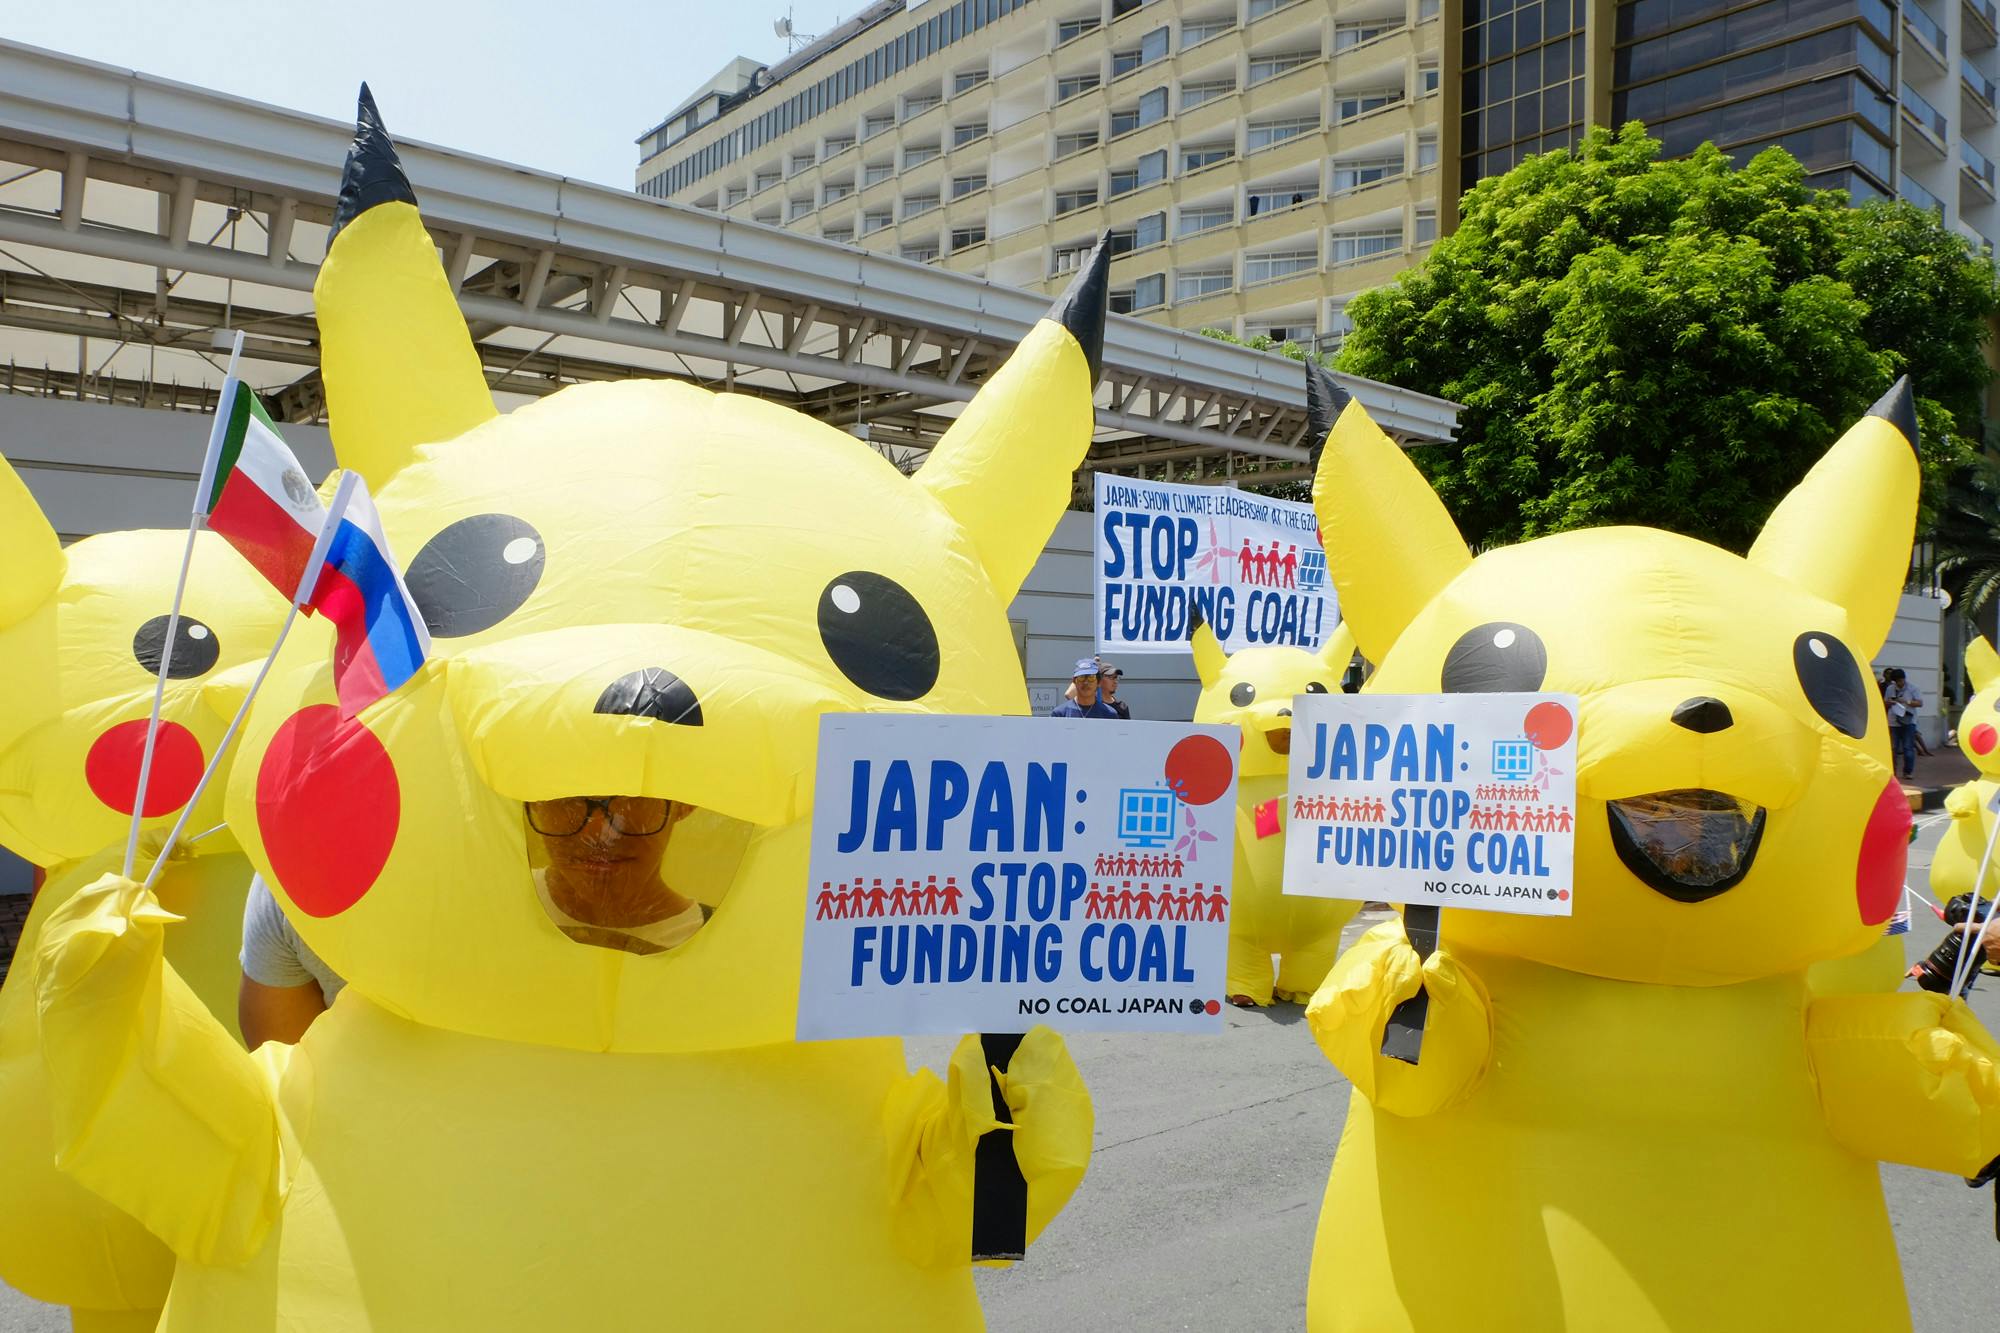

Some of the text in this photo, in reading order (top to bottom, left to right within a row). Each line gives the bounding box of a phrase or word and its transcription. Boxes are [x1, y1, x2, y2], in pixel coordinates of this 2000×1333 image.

[1144, 489, 1171, 511] SHOW
[1174, 493, 1212, 515] CLIMATE
[1216, 496, 1268, 522] LEADERSHIP
[1272, 508, 1281, 526] AT
[1284, 510, 1300, 529] THE
[1301, 513, 1317, 532] G20
[1104, 511, 1199, 580] STOP
[1104, 583, 1323, 647] FUNDING COAL!
[1307, 723, 1469, 783] JAPAN:
[837, 759, 1087, 854] JAPAN:
[1390, 788, 1471, 830] STOP
[1317, 826, 1550, 877] FUNDING COAL
[969, 862, 1087, 922] STOP
[1424, 881, 1542, 899] NO COAL JAPAN
[851, 923, 1195, 987] FUNDING COAL
[1018, 997, 1183, 1015] NO COAL JAPAN
